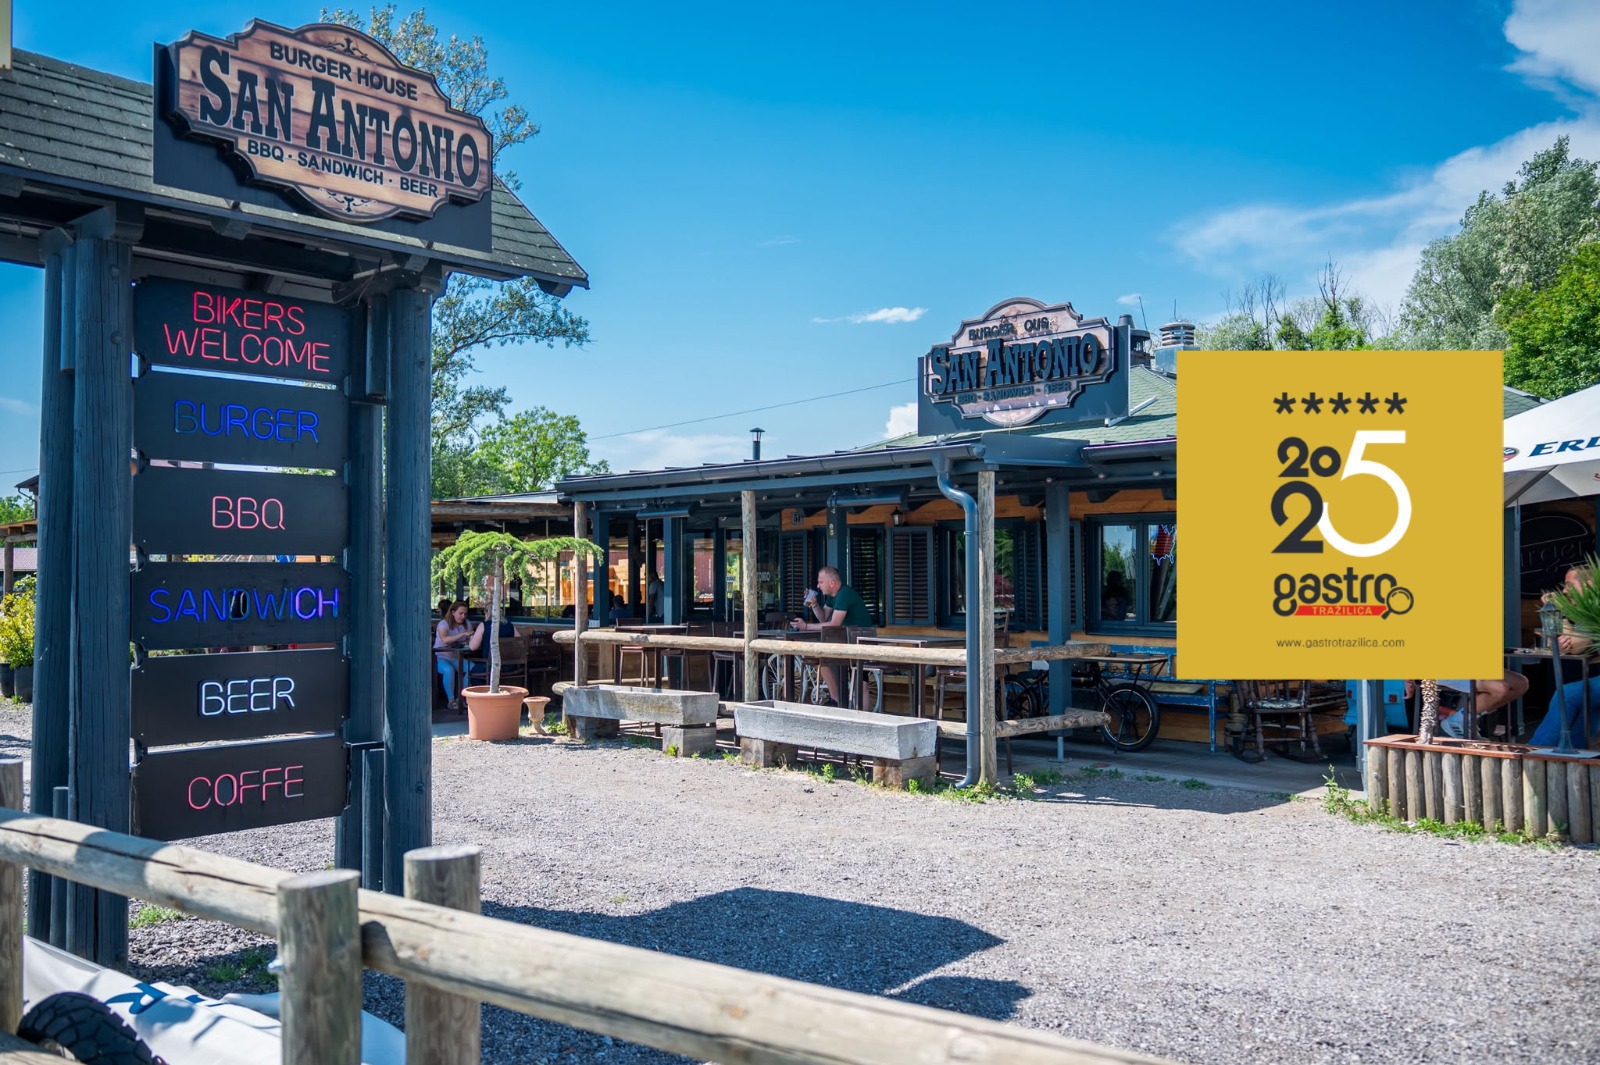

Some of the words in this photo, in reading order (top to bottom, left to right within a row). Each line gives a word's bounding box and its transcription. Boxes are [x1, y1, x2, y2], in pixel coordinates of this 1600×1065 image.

[270, 41, 352, 83] BURGER
[357, 68, 418, 101] HOUSE
[199, 45, 294, 143] SAN
[306, 76, 480, 188] ANTONIO
[247, 139, 285, 163] BBQ
[297, 151, 384, 185] SANDWICH
[400, 177, 438, 198] BEER
[193, 291, 305, 335] BIKERS
[969, 322, 1015, 341] BURGER
[163, 323, 331, 373] WELCOME
[932, 348, 981, 394] SAN
[985, 333, 1100, 388] ANTONIO
[983, 385, 1035, 402] SANDWICH
[1044, 381, 1072, 394] BEER
[174, 400, 319, 443] BURGER
[212, 495, 286, 530] BBQ
[149, 587, 340, 623] SANDWICH
[201, 676, 295, 716] BEER
[188, 765, 304, 810] COFFE
